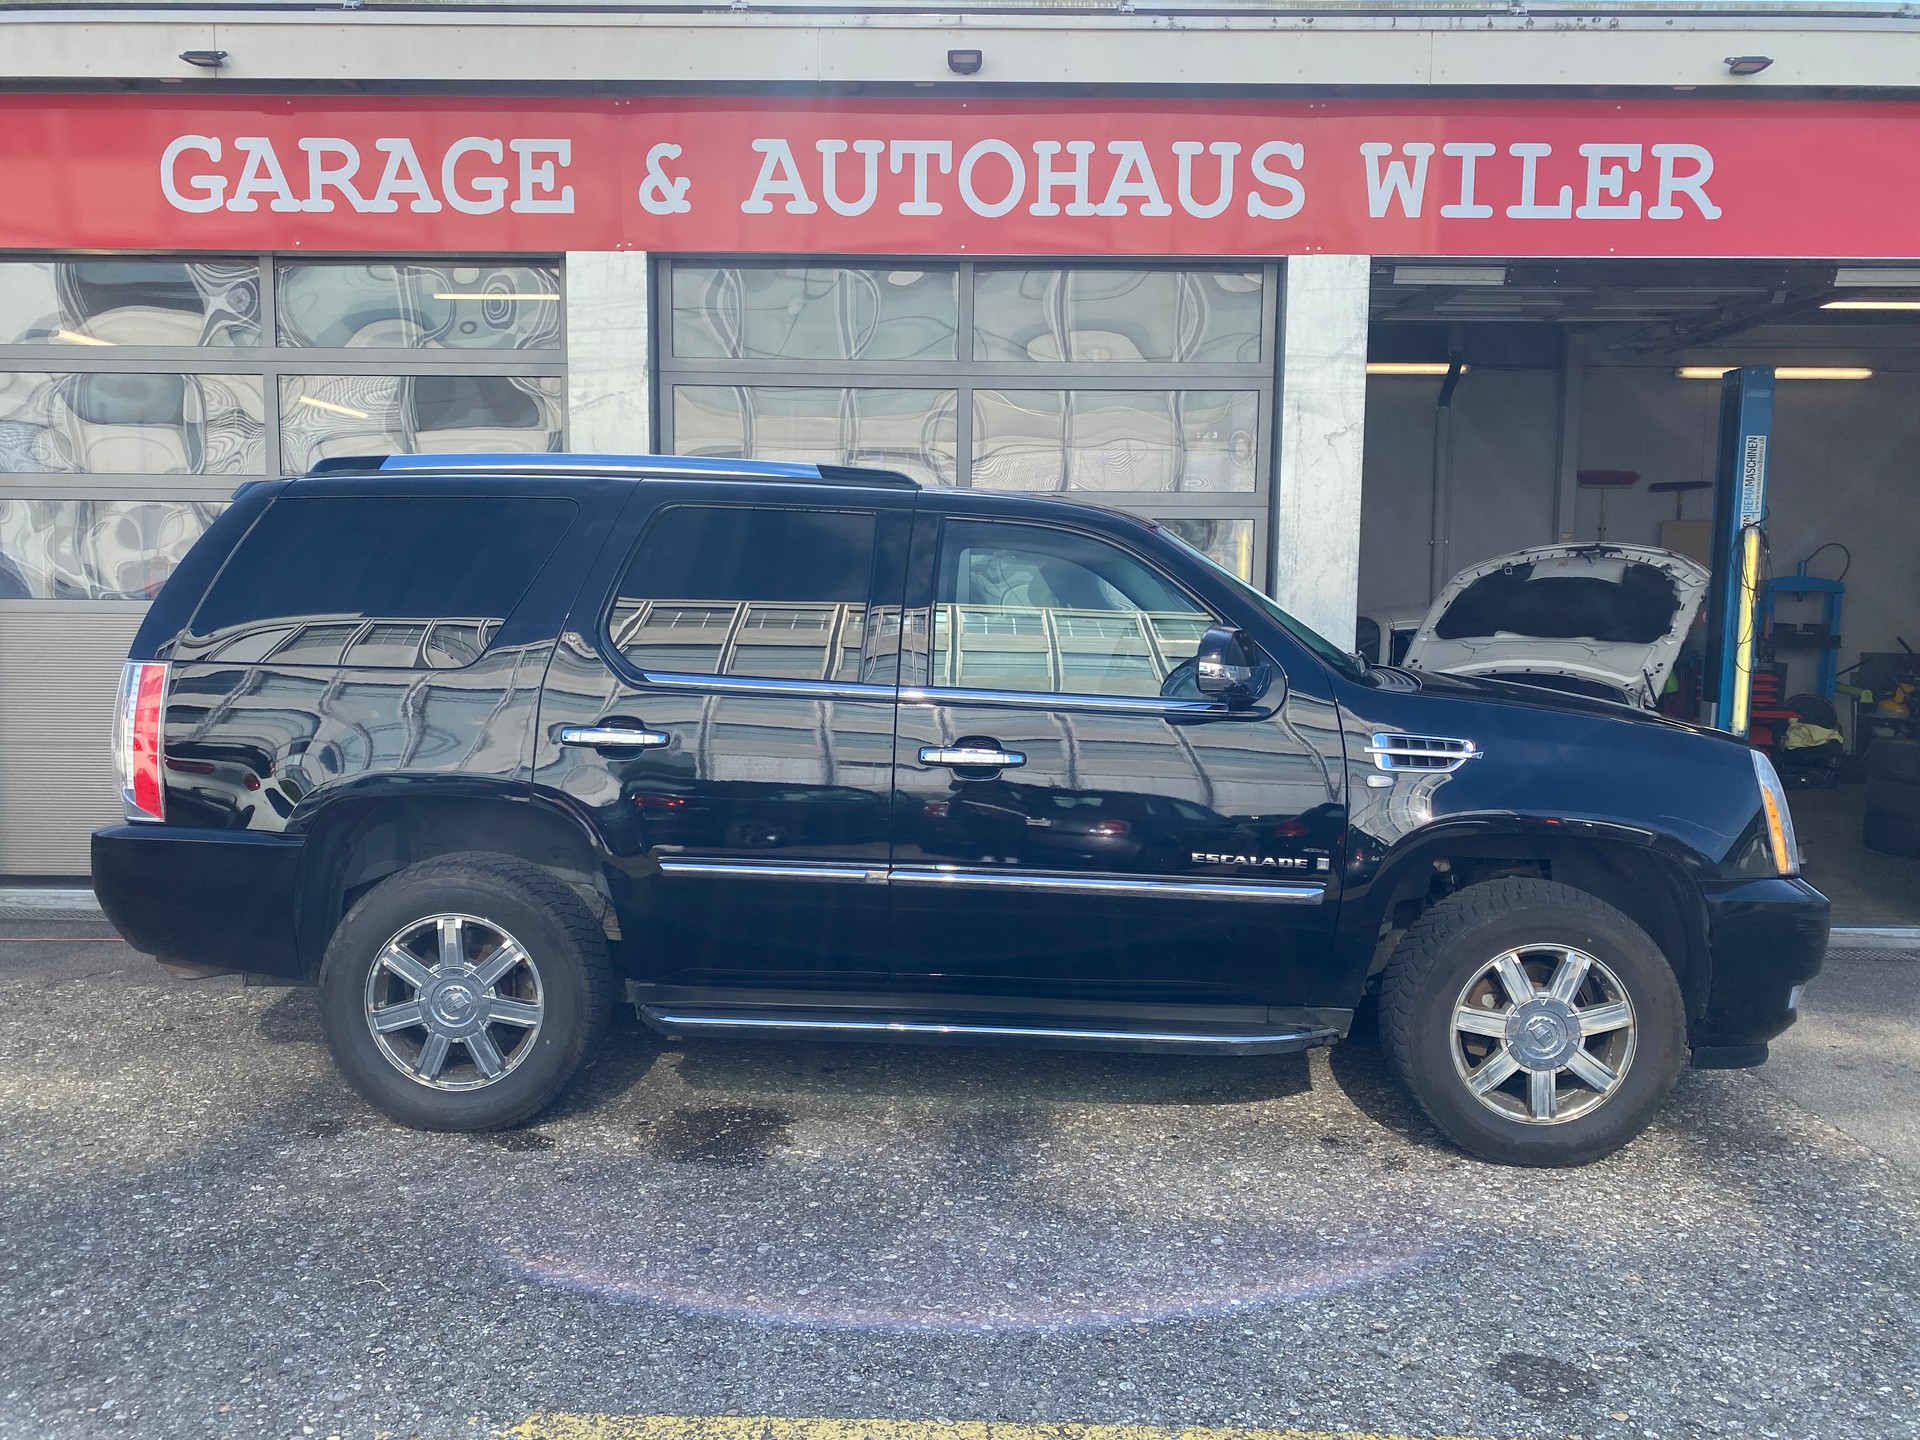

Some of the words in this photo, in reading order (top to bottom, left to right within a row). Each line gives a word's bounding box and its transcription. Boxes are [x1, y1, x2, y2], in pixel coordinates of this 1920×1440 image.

[160, 134, 575, 216] GARAGE
[639, 143, 692, 216] &
[741, 138, 1306, 220] AUTOHAUS
[1360, 142, 1723, 220] WILER
[1743, 436, 1758, 511] REMAMASCHINEN
[1191, 852, 1309, 869] ESCALADE
